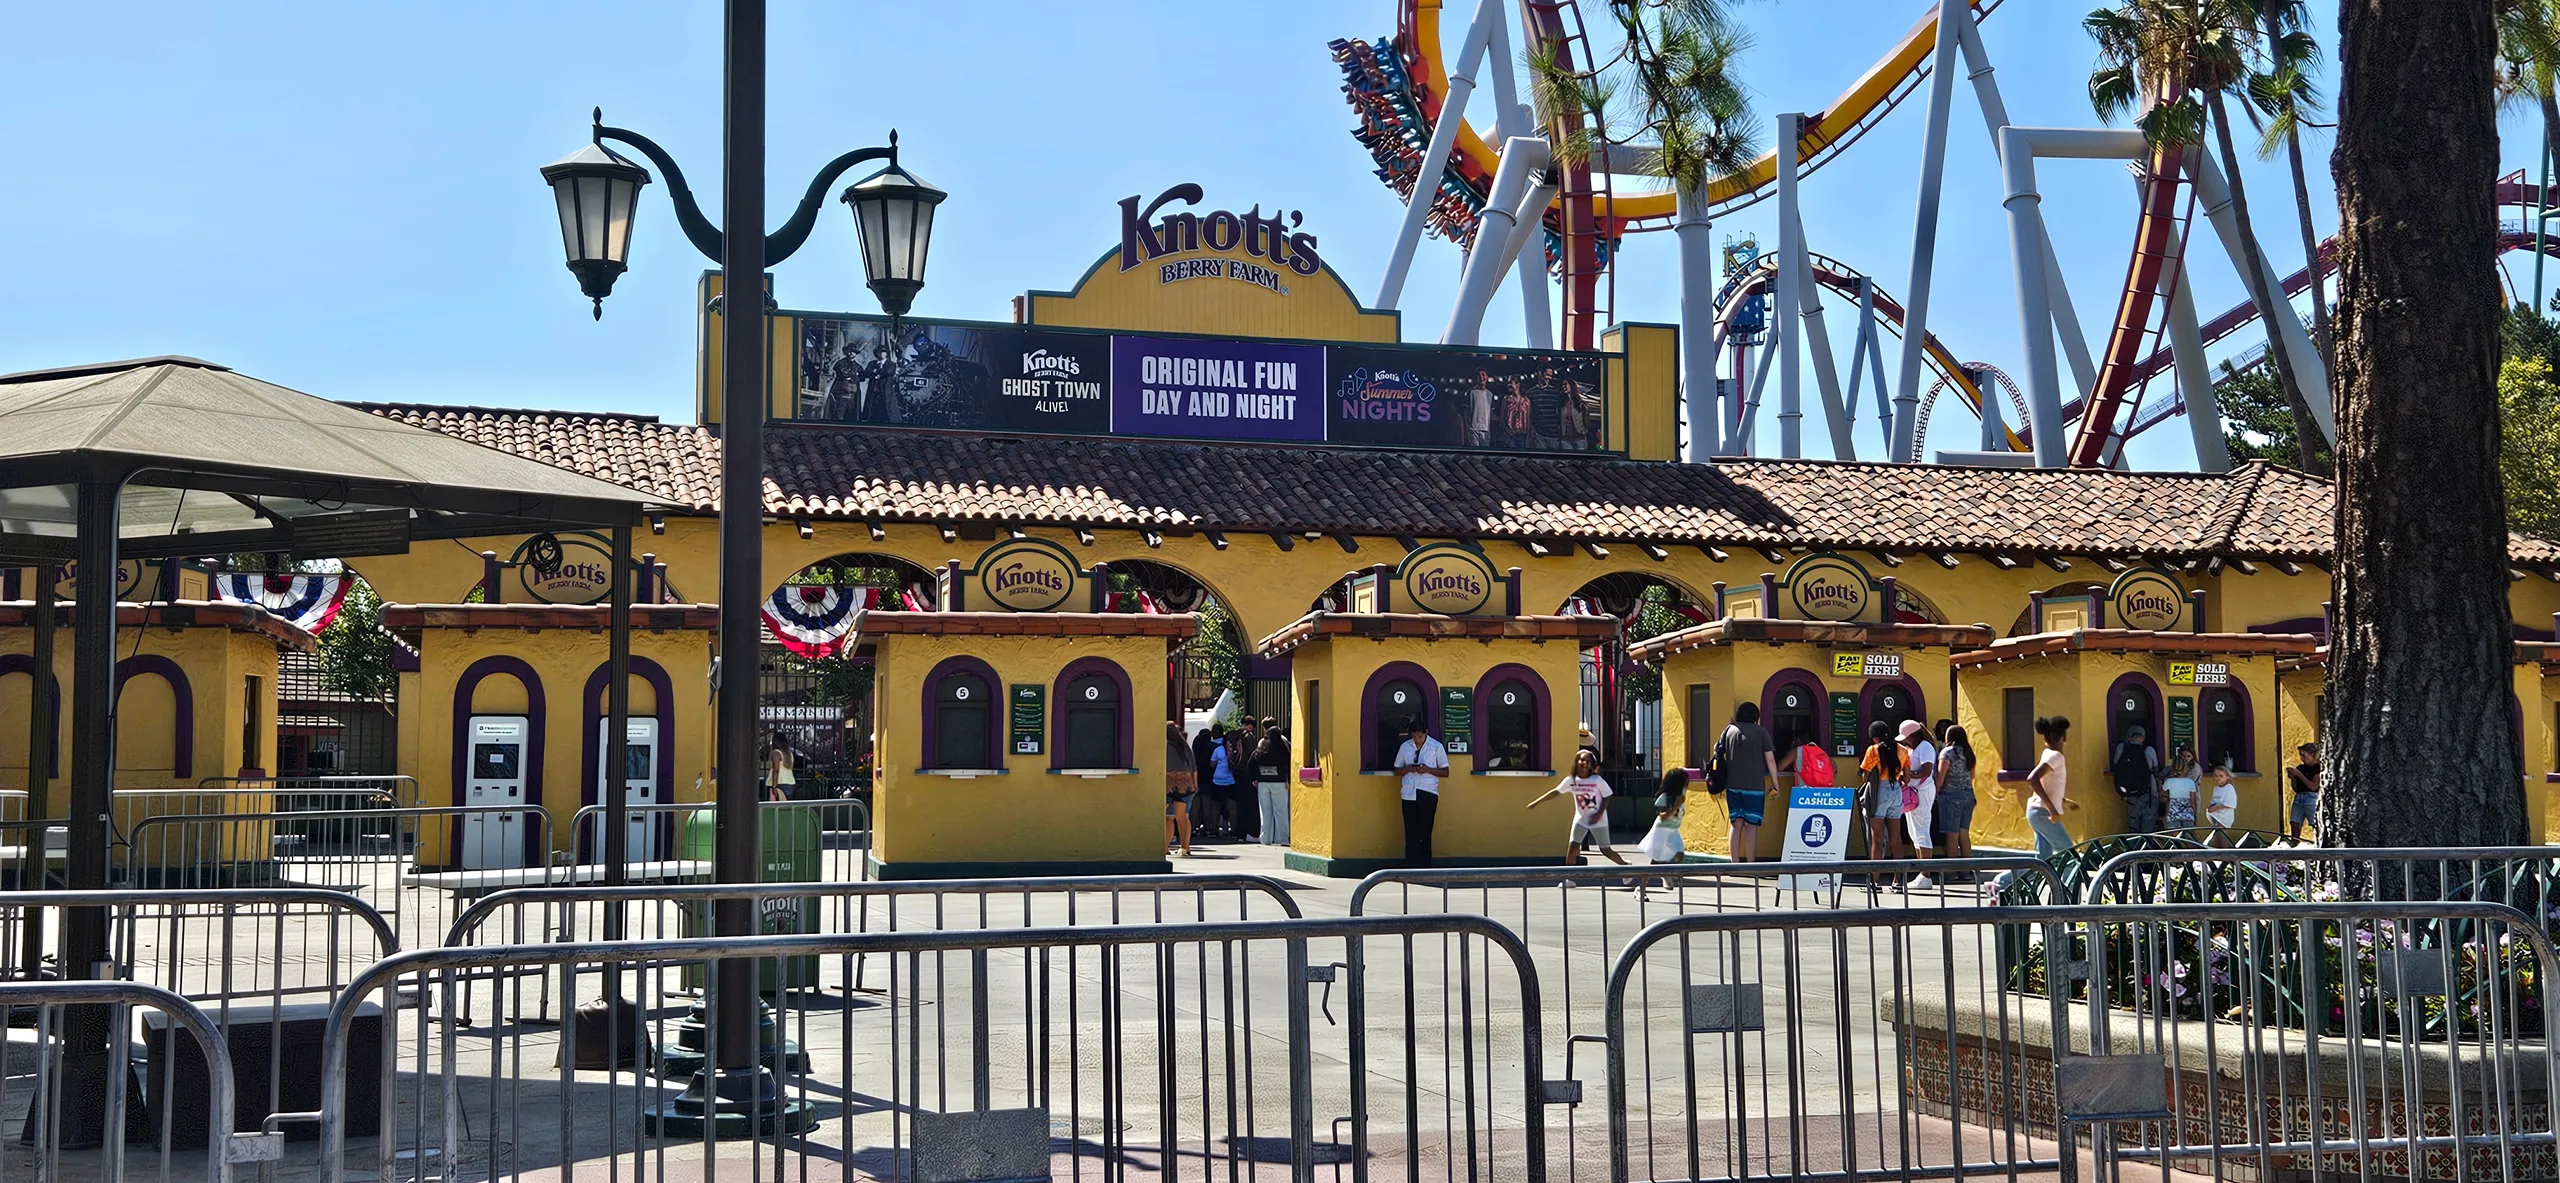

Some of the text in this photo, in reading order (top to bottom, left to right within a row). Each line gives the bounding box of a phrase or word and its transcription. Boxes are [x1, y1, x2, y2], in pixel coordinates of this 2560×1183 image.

[1117, 182, 1321, 277] Knott's
[1159, 258, 1281, 295] BERRY FARM
[1022, 348, 1080, 375] Knott's
[1141, 355, 1297, 391] ORIGINAL FUN
[1002, 378, 1101, 400] GHOST TOWN
[1360, 381, 1414, 401] Summer
[1034, 400, 1069, 413] ALIVE!
[1141, 389, 1297, 420] DAY AND NIGHT
[1342, 399, 1432, 422] NIGHTS
[995, 562, 1063, 592] Knott's
[1418, 567, 1481, 596] Knott's
[1803, 577, 1858, 605] Knott's
[2125, 590, 2174, 615] Knott's
[1863, 665, 1900, 676] HERE
[1866, 654, 1899, 666] SOLD
[2196, 663, 2226, 674] SOLD
[2194, 673, 2227, 684] HERE
[1798, 797, 1845, 806] CASHLESS
